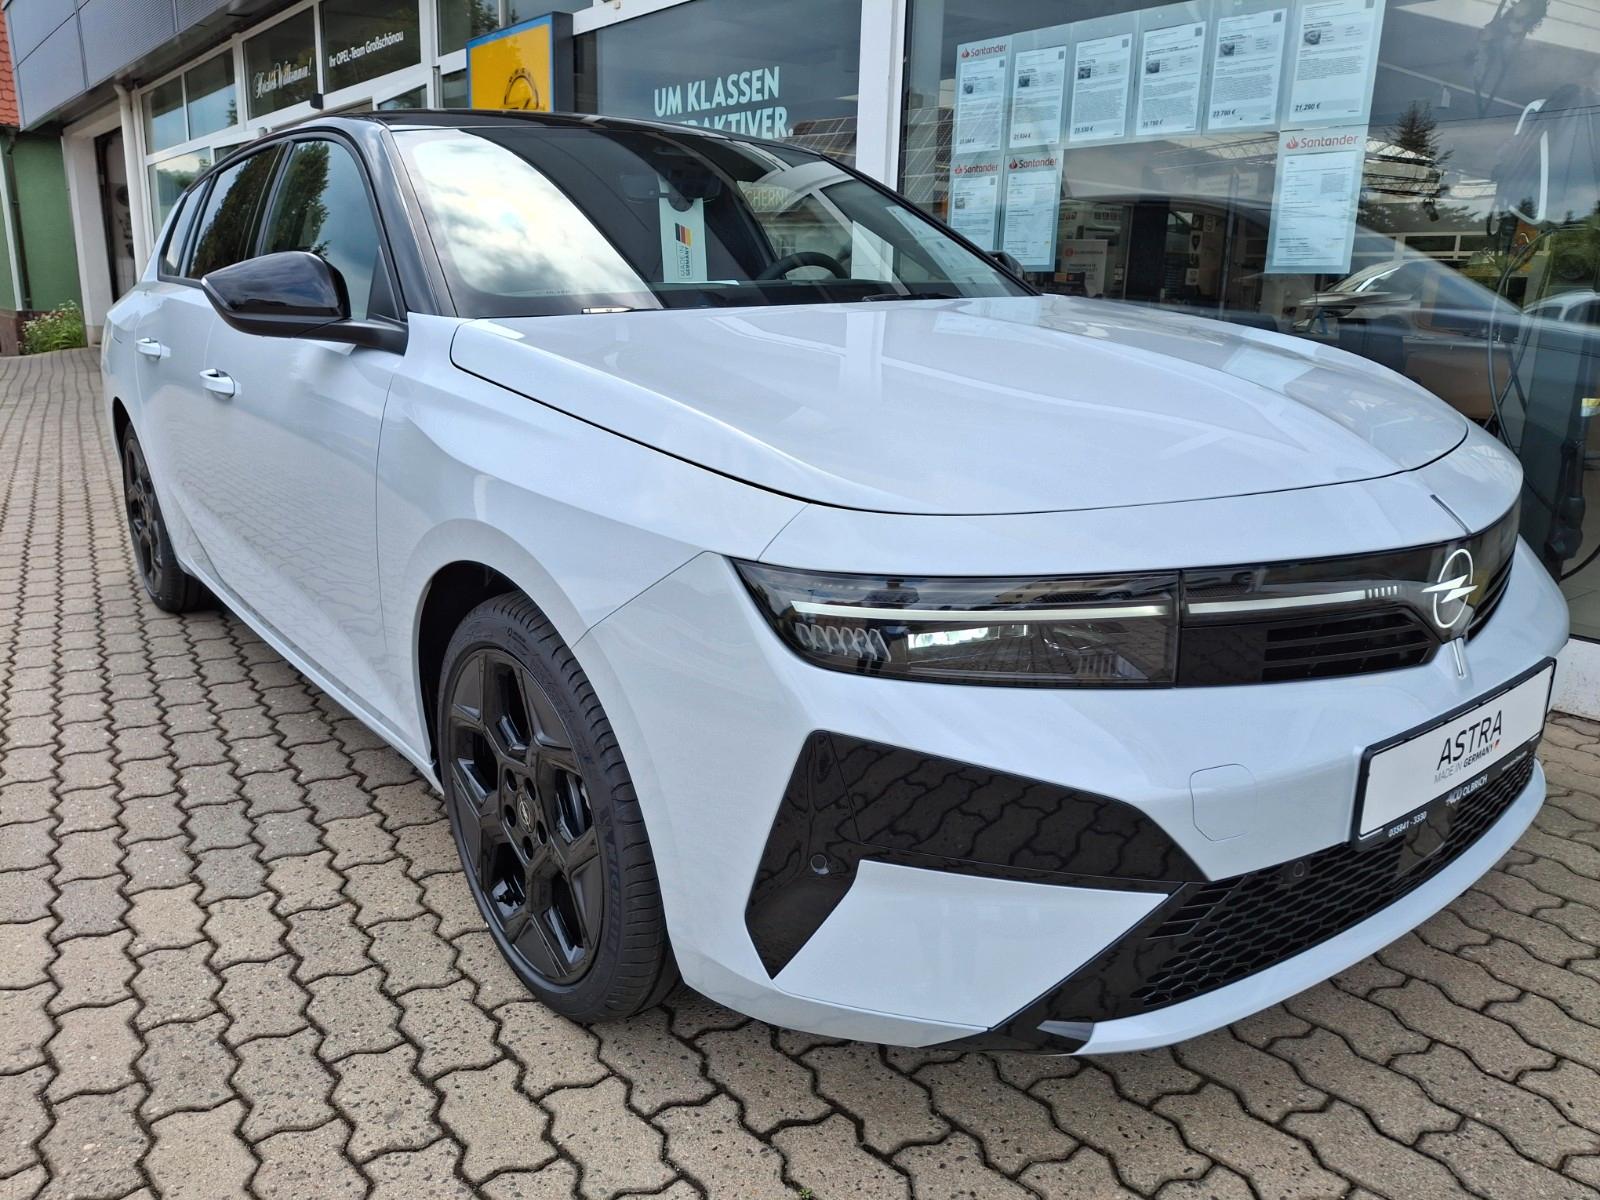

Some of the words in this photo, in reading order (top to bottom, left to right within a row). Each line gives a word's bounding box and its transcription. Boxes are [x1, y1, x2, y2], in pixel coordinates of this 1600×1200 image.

[328, 55, 336, 67] Ihr
[365, 30, 404, 54] Großschönau
[970, 44, 1007, 57] Santander
[654, 84, 683, 118] UM
[687, 66, 780, 113] KLASSEN
[1300, 134, 1358, 149] Santander
[964, 163, 998, 174] Santander
[1019, 158, 1057, 169] Santander
[1436, 710, 1502, 771] ASTRA
[1463, 744, 1494, 768] GERMANY
[1463, 774, 1489, 796] OLBRICH
